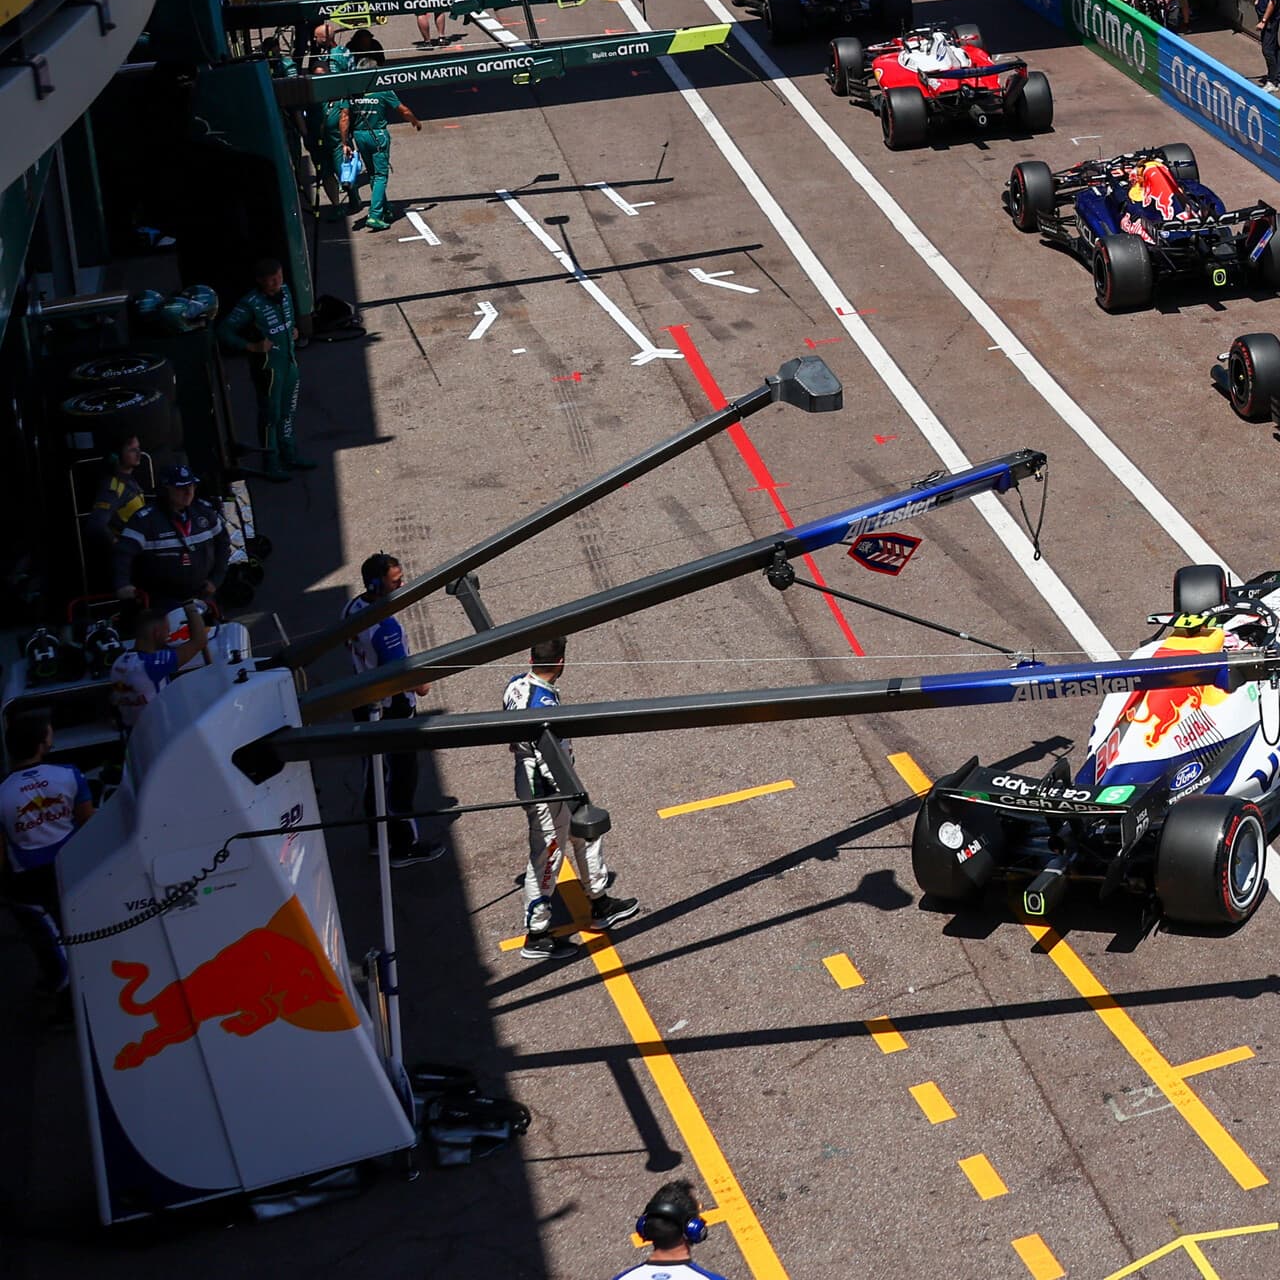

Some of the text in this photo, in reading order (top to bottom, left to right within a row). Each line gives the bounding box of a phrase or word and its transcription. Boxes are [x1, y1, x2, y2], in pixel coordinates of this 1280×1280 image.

[375, 72, 418, 87] ASTON
[420, 65, 468, 80] MARTIN
[476, 55, 535, 74] aramco
[617, 41, 650, 57] arm
[1171, 54, 1265, 155] aramco
[842, 494, 937, 543] Airtasker
[1011, 674, 1142, 703] Airtasker
[1174, 713, 1217, 751] Red Bull
[1168, 775, 1211, 806] RACING
[1175, 765, 1200, 789] Ford
[1000, 795, 1048, 811] Cash
[957, 838, 981, 864] Mobil
[125, 896, 157, 912] VISA
